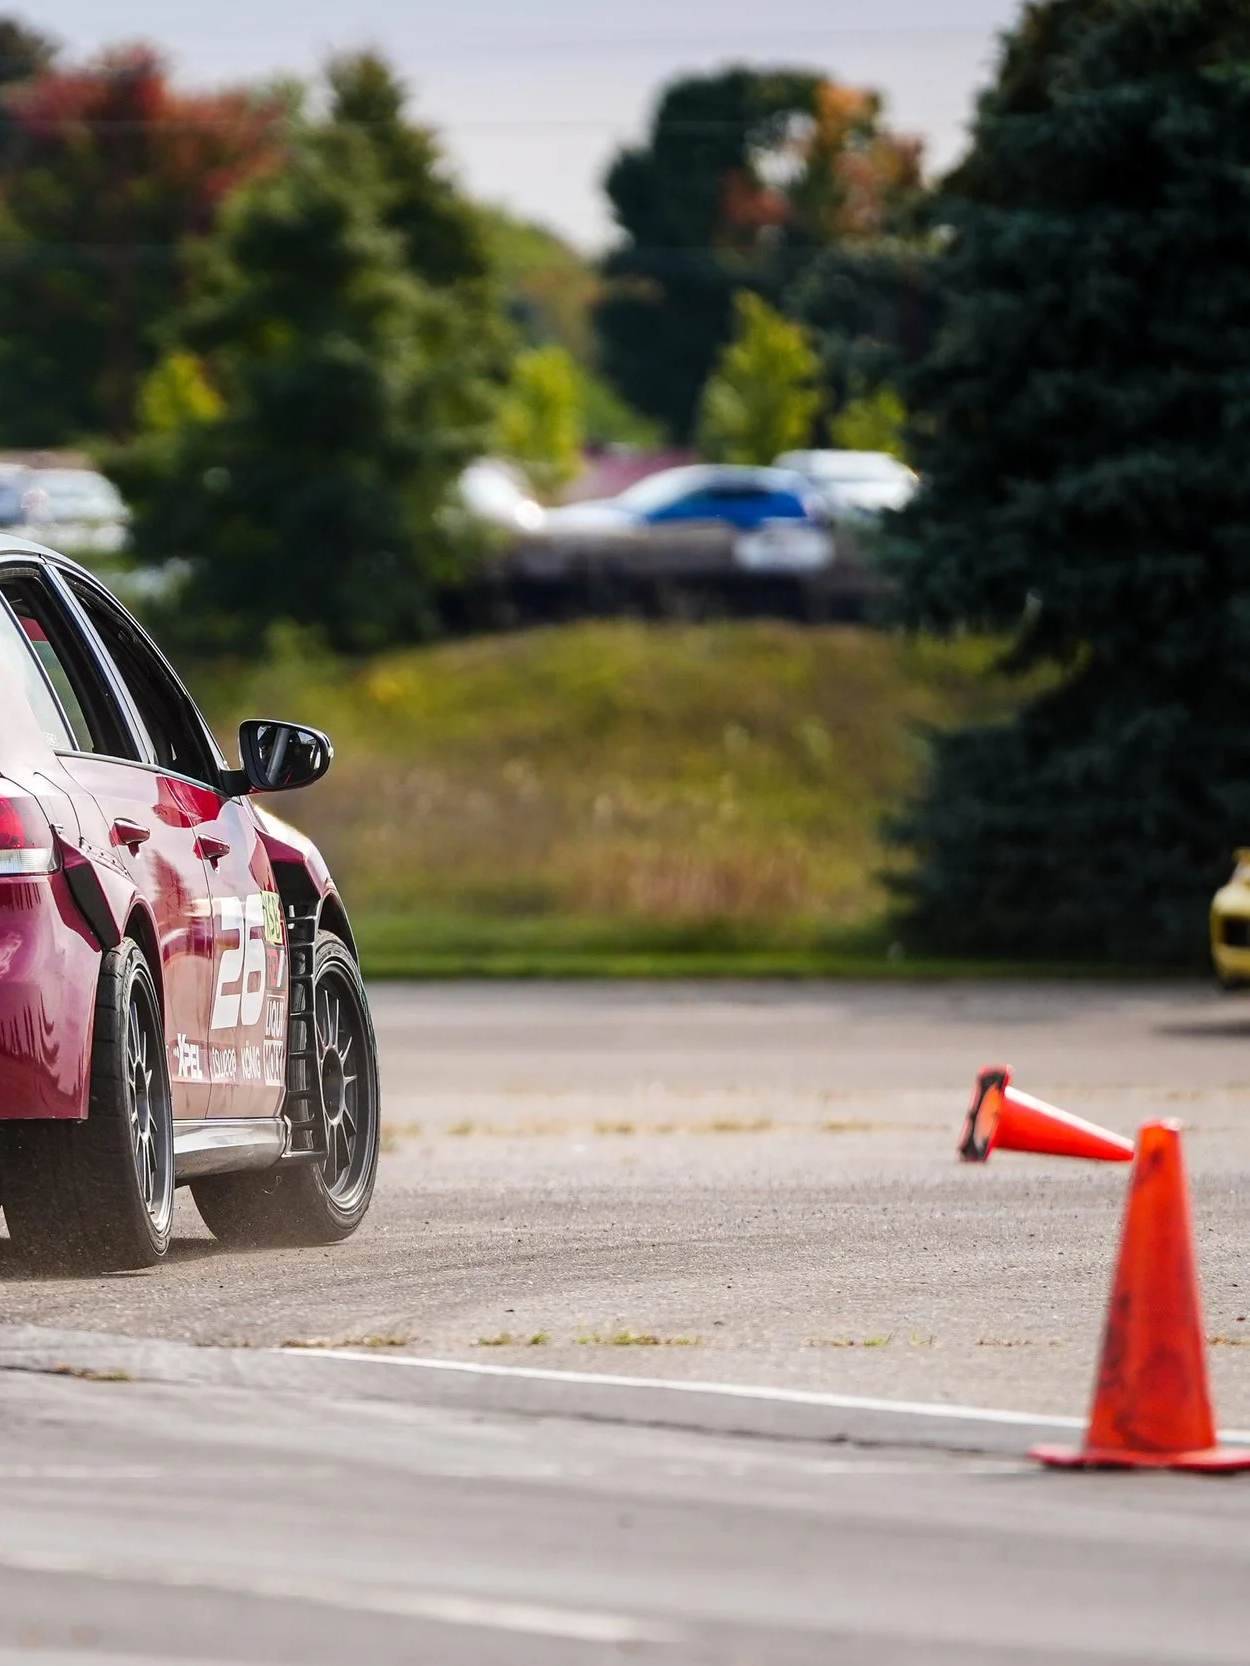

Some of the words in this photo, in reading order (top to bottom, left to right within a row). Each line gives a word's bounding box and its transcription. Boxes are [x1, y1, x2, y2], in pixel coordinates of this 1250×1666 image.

[211, 893, 266, 1030] 26
[266, 1001, 284, 1038] LIQUI
[177, 1033, 203, 1080] XPEL
